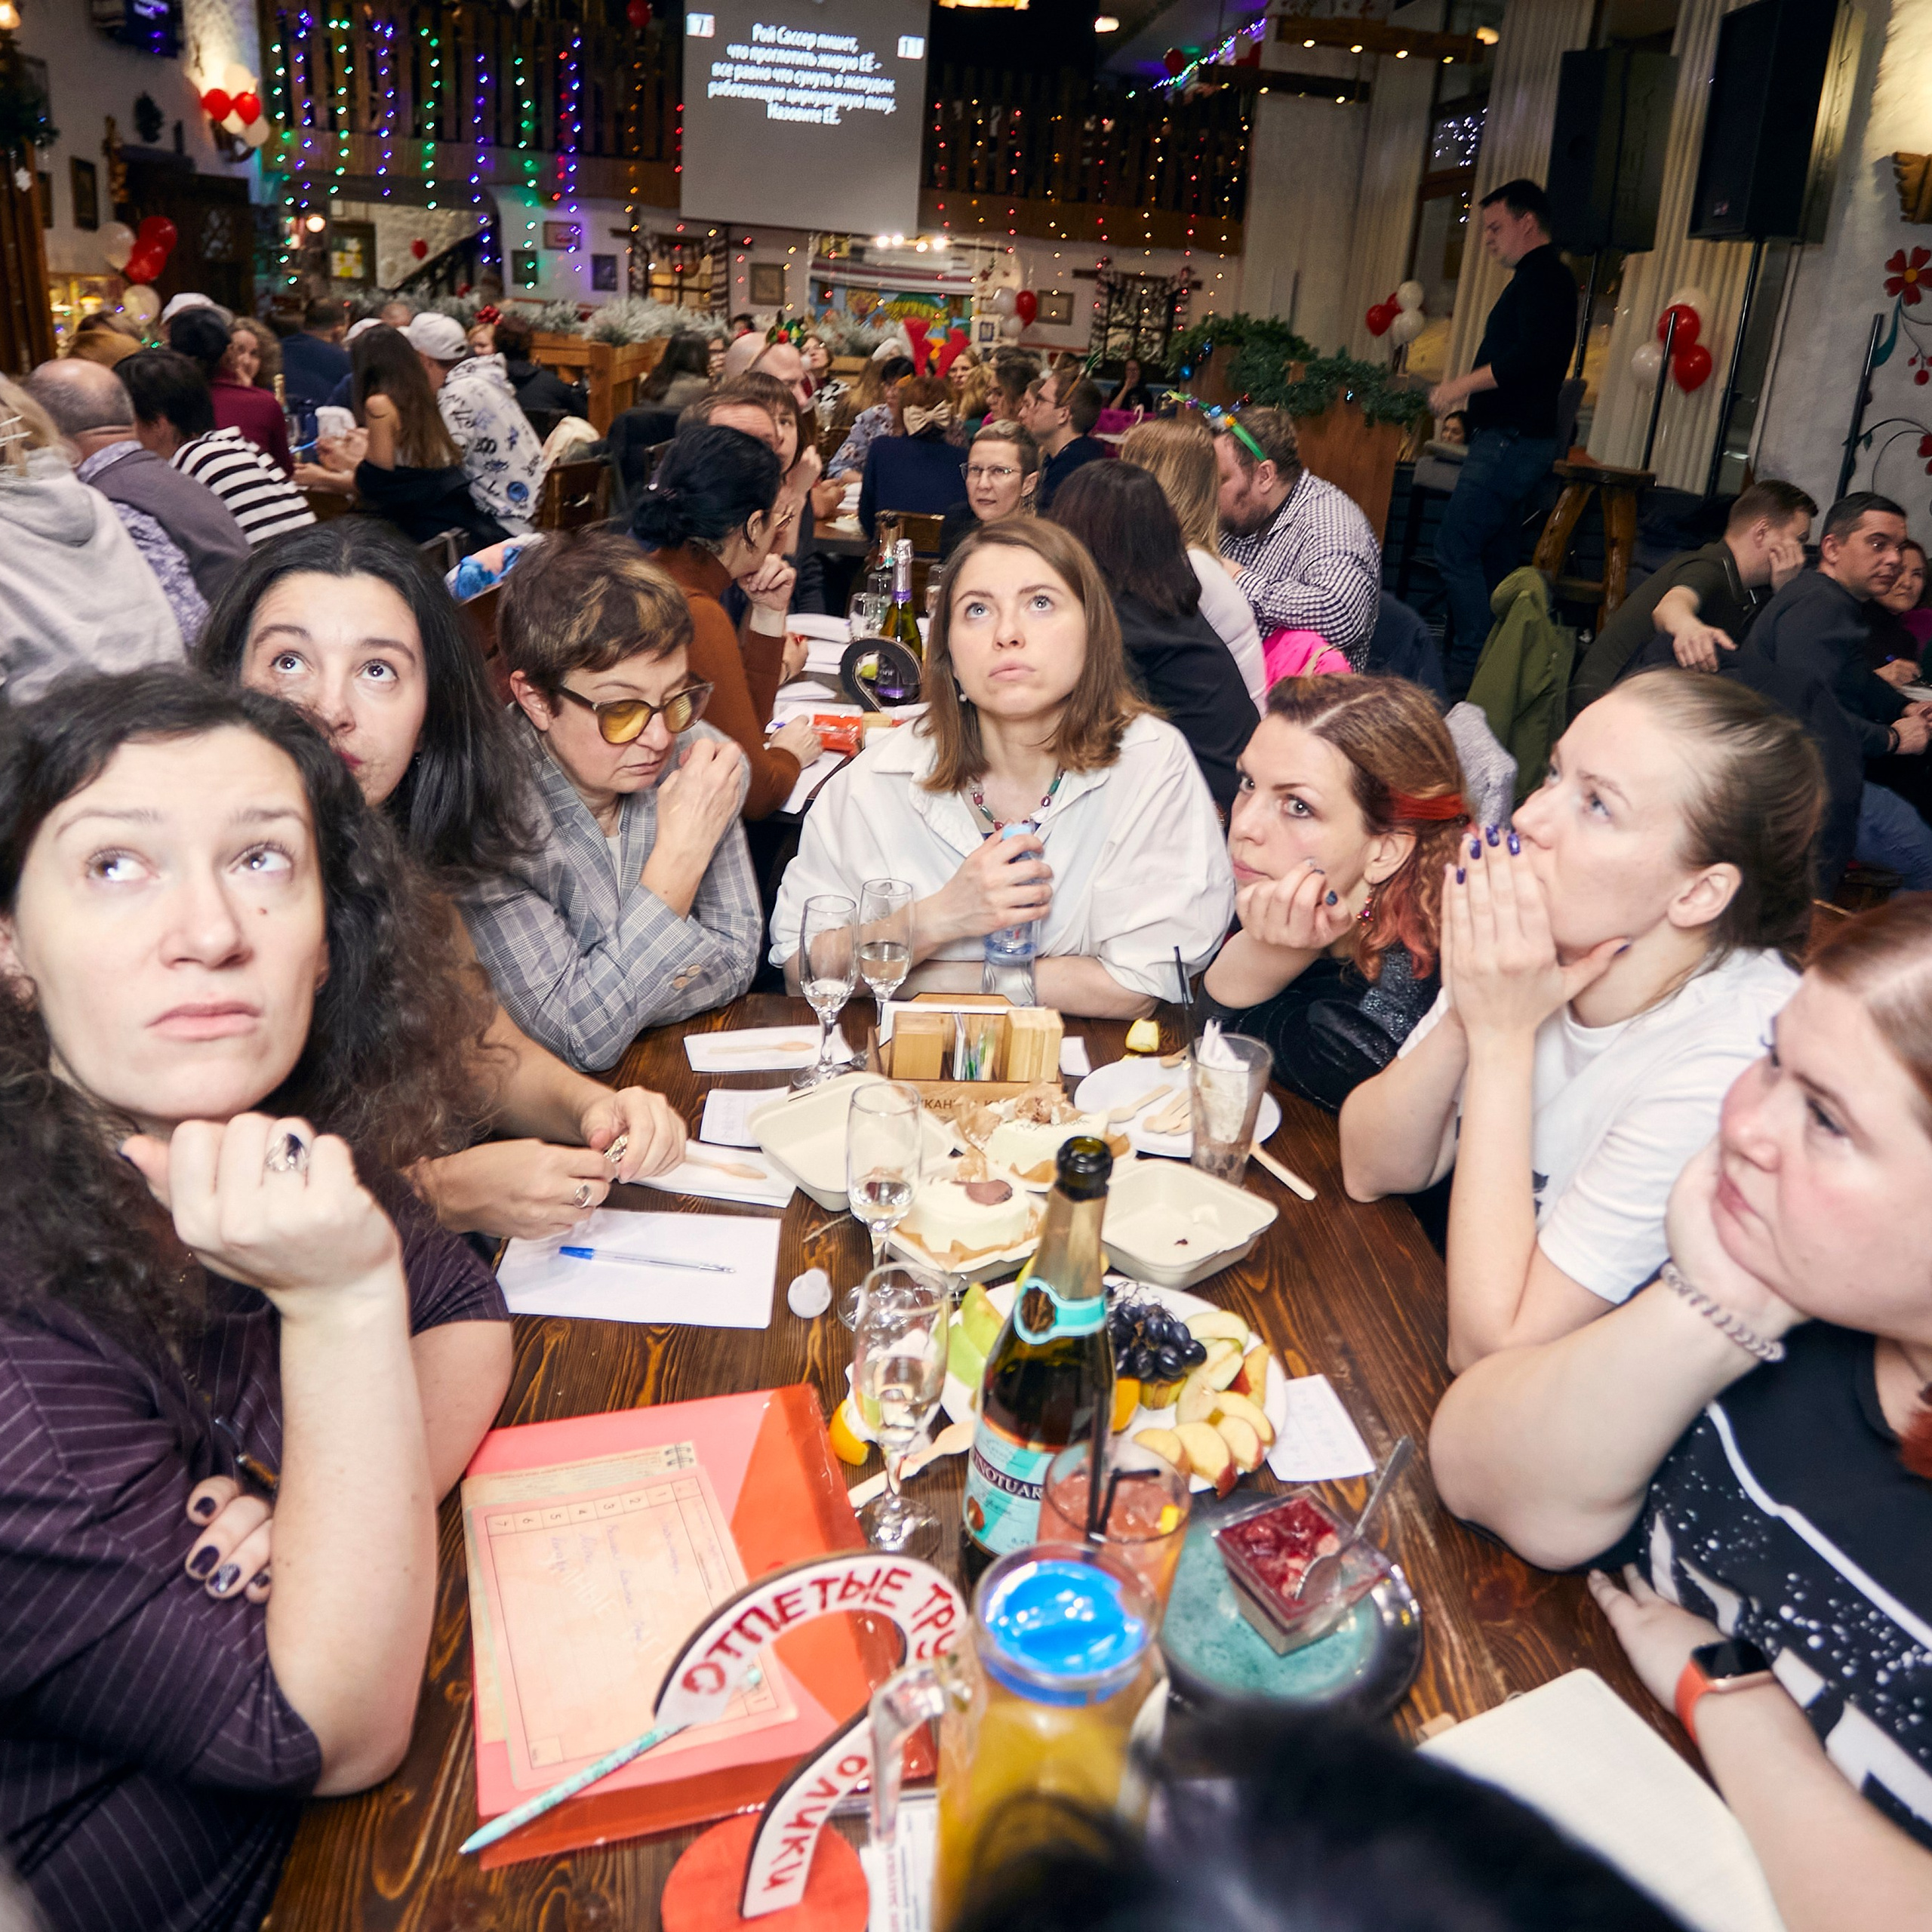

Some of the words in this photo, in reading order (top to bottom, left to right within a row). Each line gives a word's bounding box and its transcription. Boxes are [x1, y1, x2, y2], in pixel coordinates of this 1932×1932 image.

[752, 23, 777, 43] Рой
[817, 33, 860, 54] пишет,
[726, 44, 749, 60] что
[749, 46, 817, 67] проглотить
[817, 52, 859, 73] живую
[734, 63, 772, 82] равно
[772, 67, 794, 83] что
[794, 69, 834, 89] сунуть
[834, 72, 843, 88] в
[843, 74, 896, 94] желудок
[708, 79, 786, 103] работающую
[786, 87, 865, 111] циркулярную
[865, 94, 897, 115] пилу.
[767, 101, 823, 123] Назовите
[681, 1567, 912, 1695] ОТПЕТЫЕ
